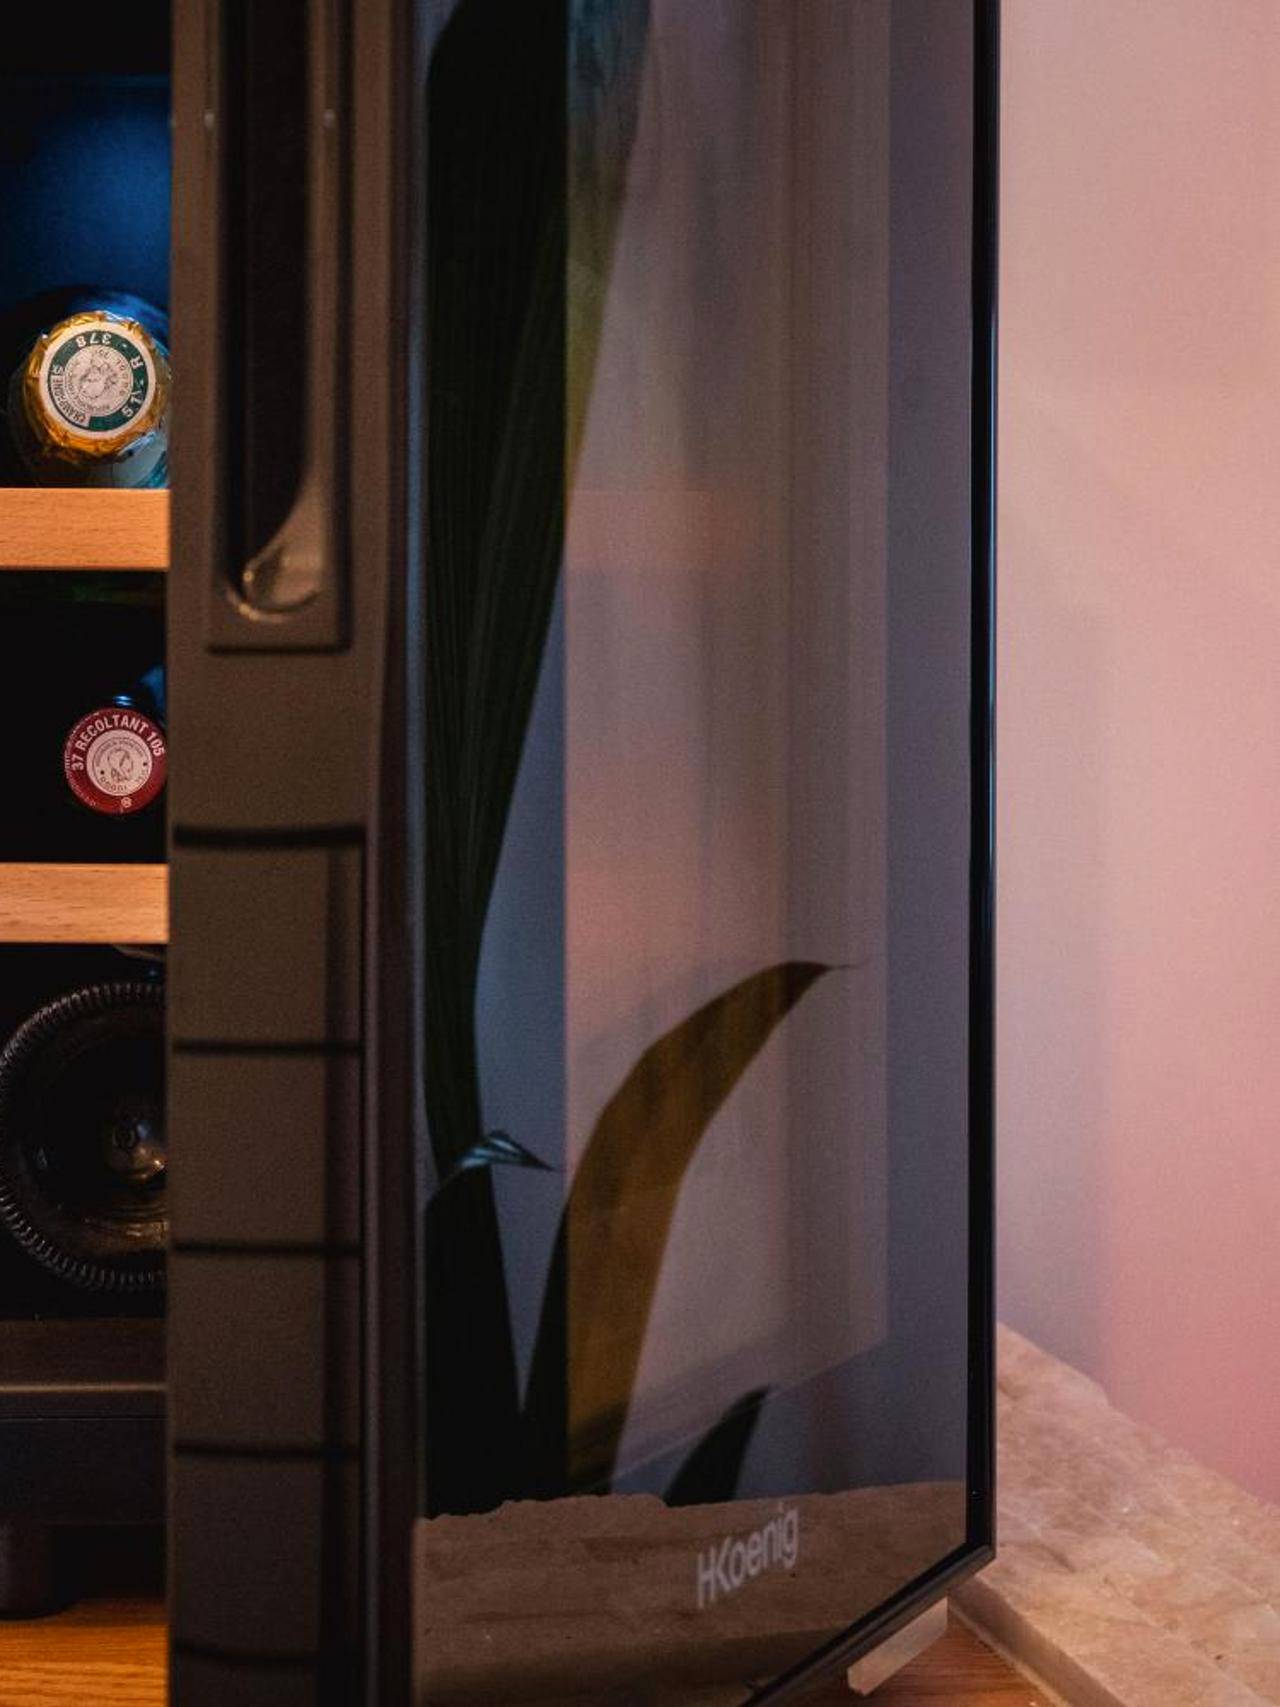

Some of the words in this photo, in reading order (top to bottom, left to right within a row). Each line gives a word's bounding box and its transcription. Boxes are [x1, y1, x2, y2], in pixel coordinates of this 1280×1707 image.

[76, 333, 112, 347] 378
[75, 714, 149, 751] RECOLTANT
[147, 732, 165, 757] 105
[72, 754, 84, 771] 37
